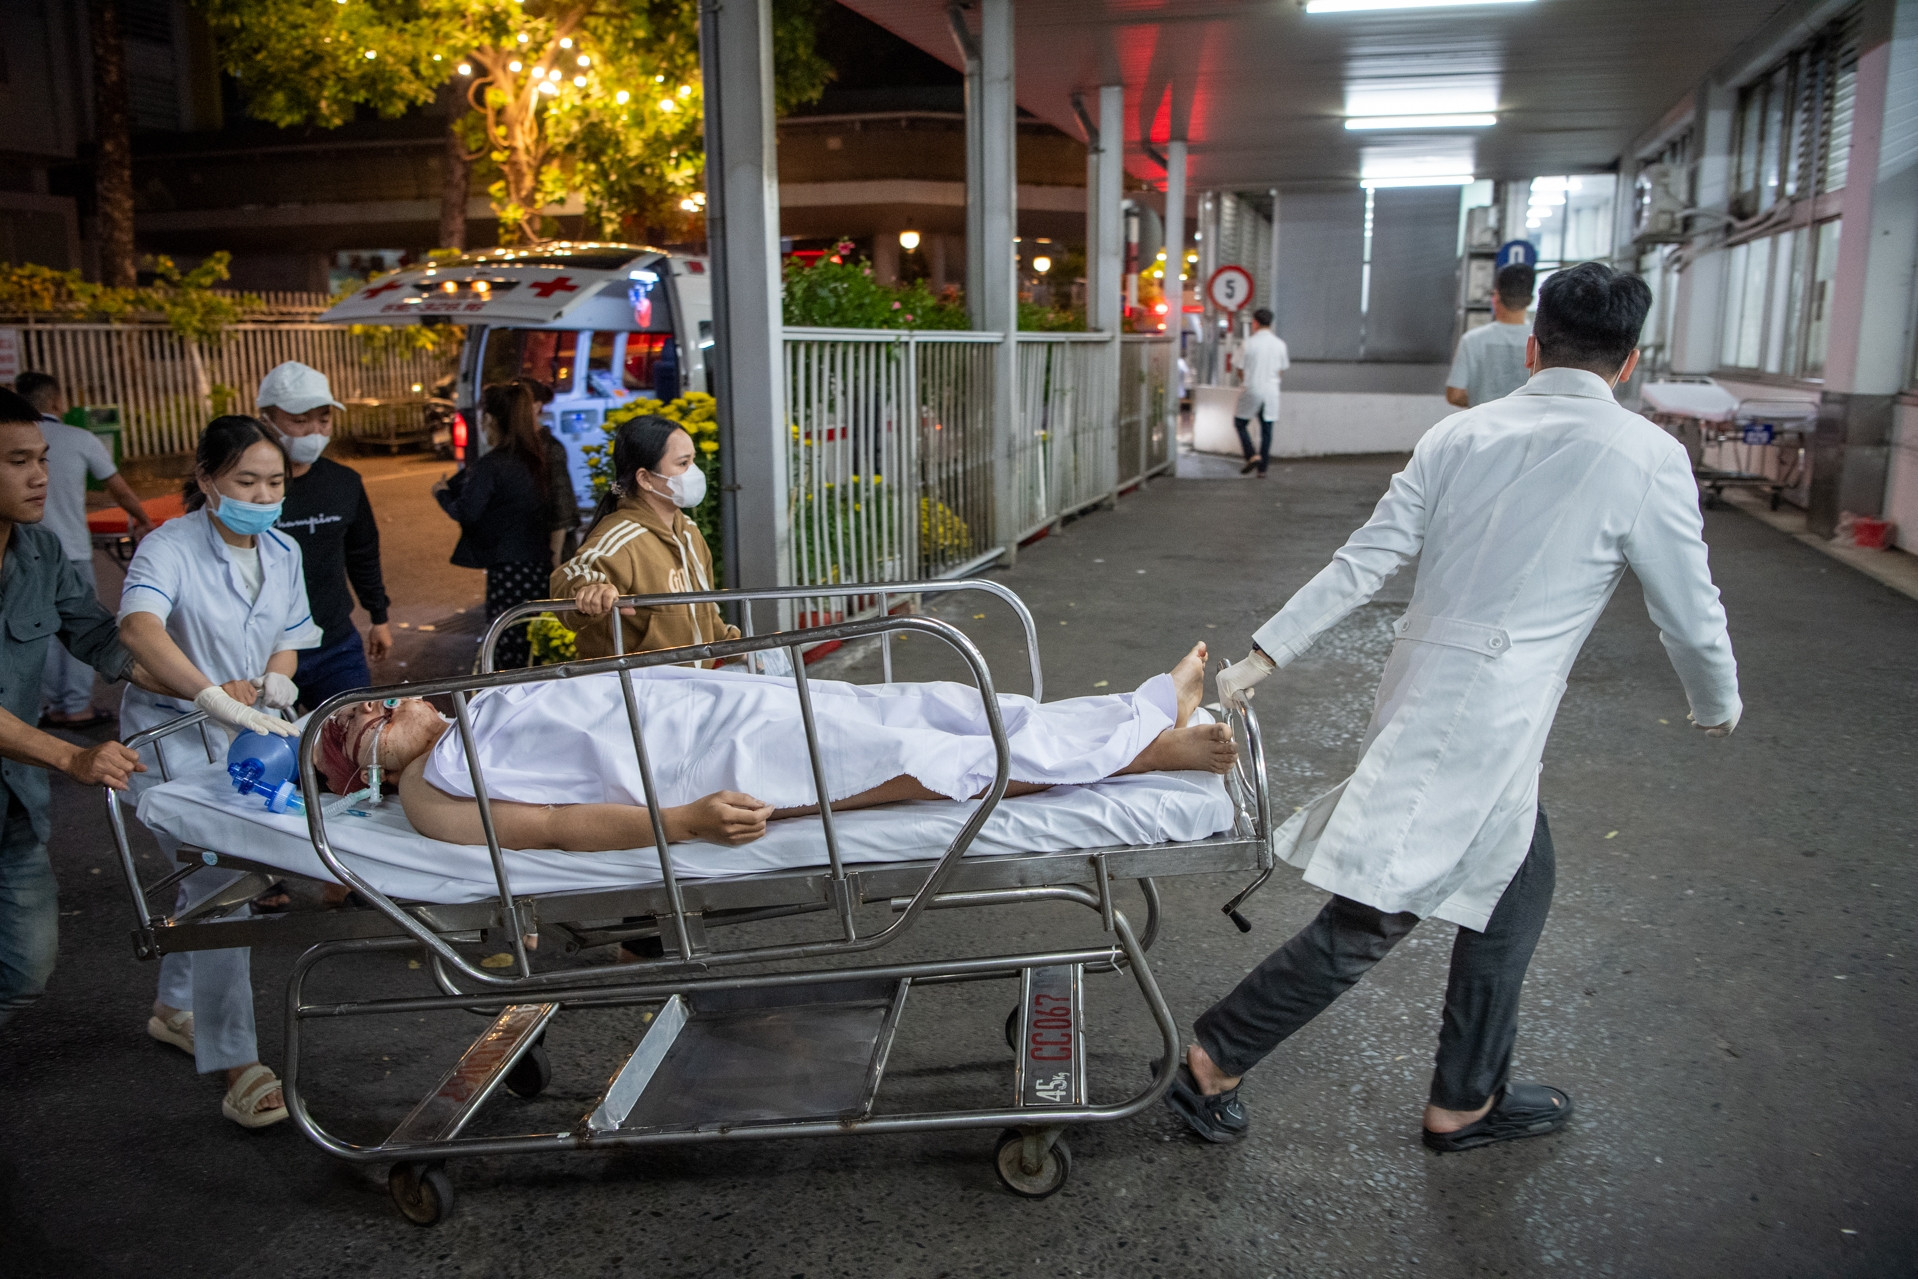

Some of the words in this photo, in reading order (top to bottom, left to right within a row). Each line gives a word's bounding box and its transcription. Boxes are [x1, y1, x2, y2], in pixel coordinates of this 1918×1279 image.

[1225, 279, 1236, 300] 5
[273, 513, 342, 534] hampion
[1030, 994, 1072, 1061] CC067
